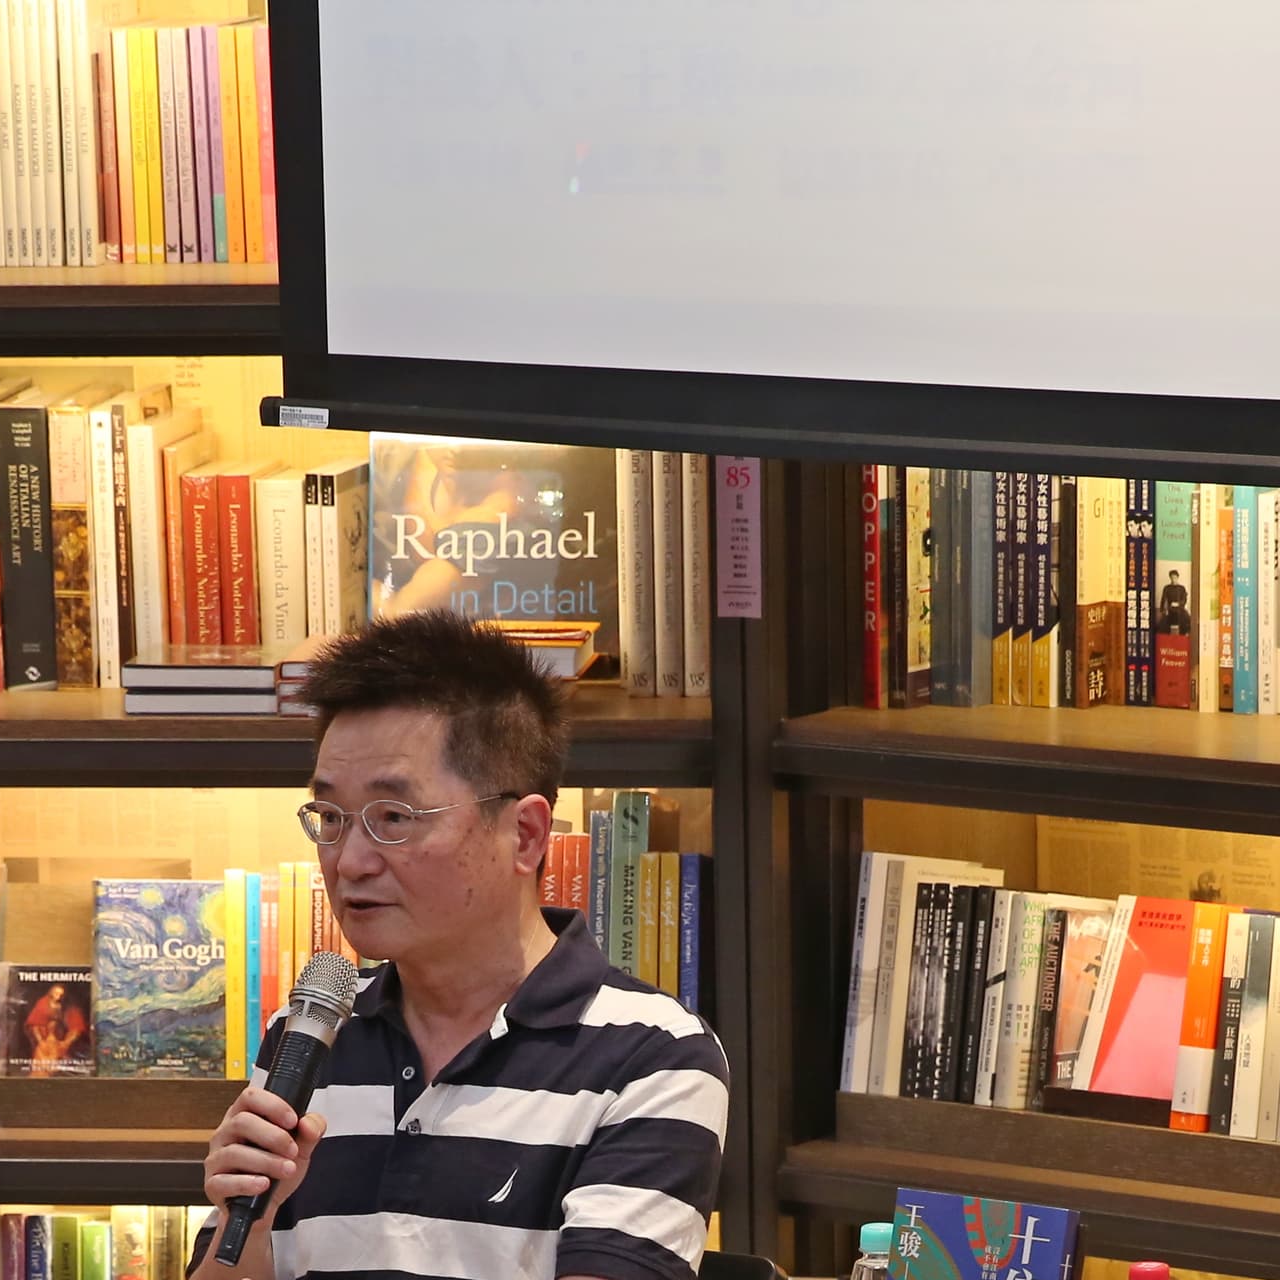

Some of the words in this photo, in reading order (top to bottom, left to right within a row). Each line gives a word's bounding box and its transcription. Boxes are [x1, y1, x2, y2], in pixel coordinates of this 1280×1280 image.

[18, 465, 30, 482] OF
[28, 464, 40, 473] A
[725, 465, 751, 489] 85
[29, 474, 41, 502] NEW
[7, 465, 21, 543] RENAISSANCE
[20, 483, 32, 528] ITALIAN
[30, 504, 44, 553] HISTORY
[192, 503, 208, 574] Leonardo's
[228, 503, 244, 573] Leonardo's
[1162, 530, 1186, 540] Freud
[10, 544, 23, 567] ART
[271, 507, 288, 580] Leonardo
[391, 513, 598, 578] Raphael
[862, 465, 878, 632] HOPPER
[274, 582, 287, 599] da
[450, 584, 480, 616] in
[494, 581, 598, 615] Detail
[196, 576, 210, 644] Notebooks
[230, 576, 245, 644] Notebooks
[274, 602, 290, 641] Vinci
[1160, 647, 1188, 657] William
[1161, 658, 1187, 668] Feaver
[596, 827, 608, 854] Living
[596, 856, 607, 877] with
[545, 874, 557, 902] VAN
[571, 874, 584, 903] VAN
[595, 878, 607, 914] Vincent
[621, 864, 635, 926] MAKING
[594, 917, 604, 934] van
[1049, 920, 1062, 942] THE
[114, 938, 158, 959] Van
[162, 937, 225, 966] Gogh
[621, 930, 634, 961] VAN
[18, 972, 38, 982] THE
[1041, 944, 1060, 1012] AUCTIONEER
[1056, 1061, 1072, 1080] THE
[898, 1203, 926, 1259] 王駿
